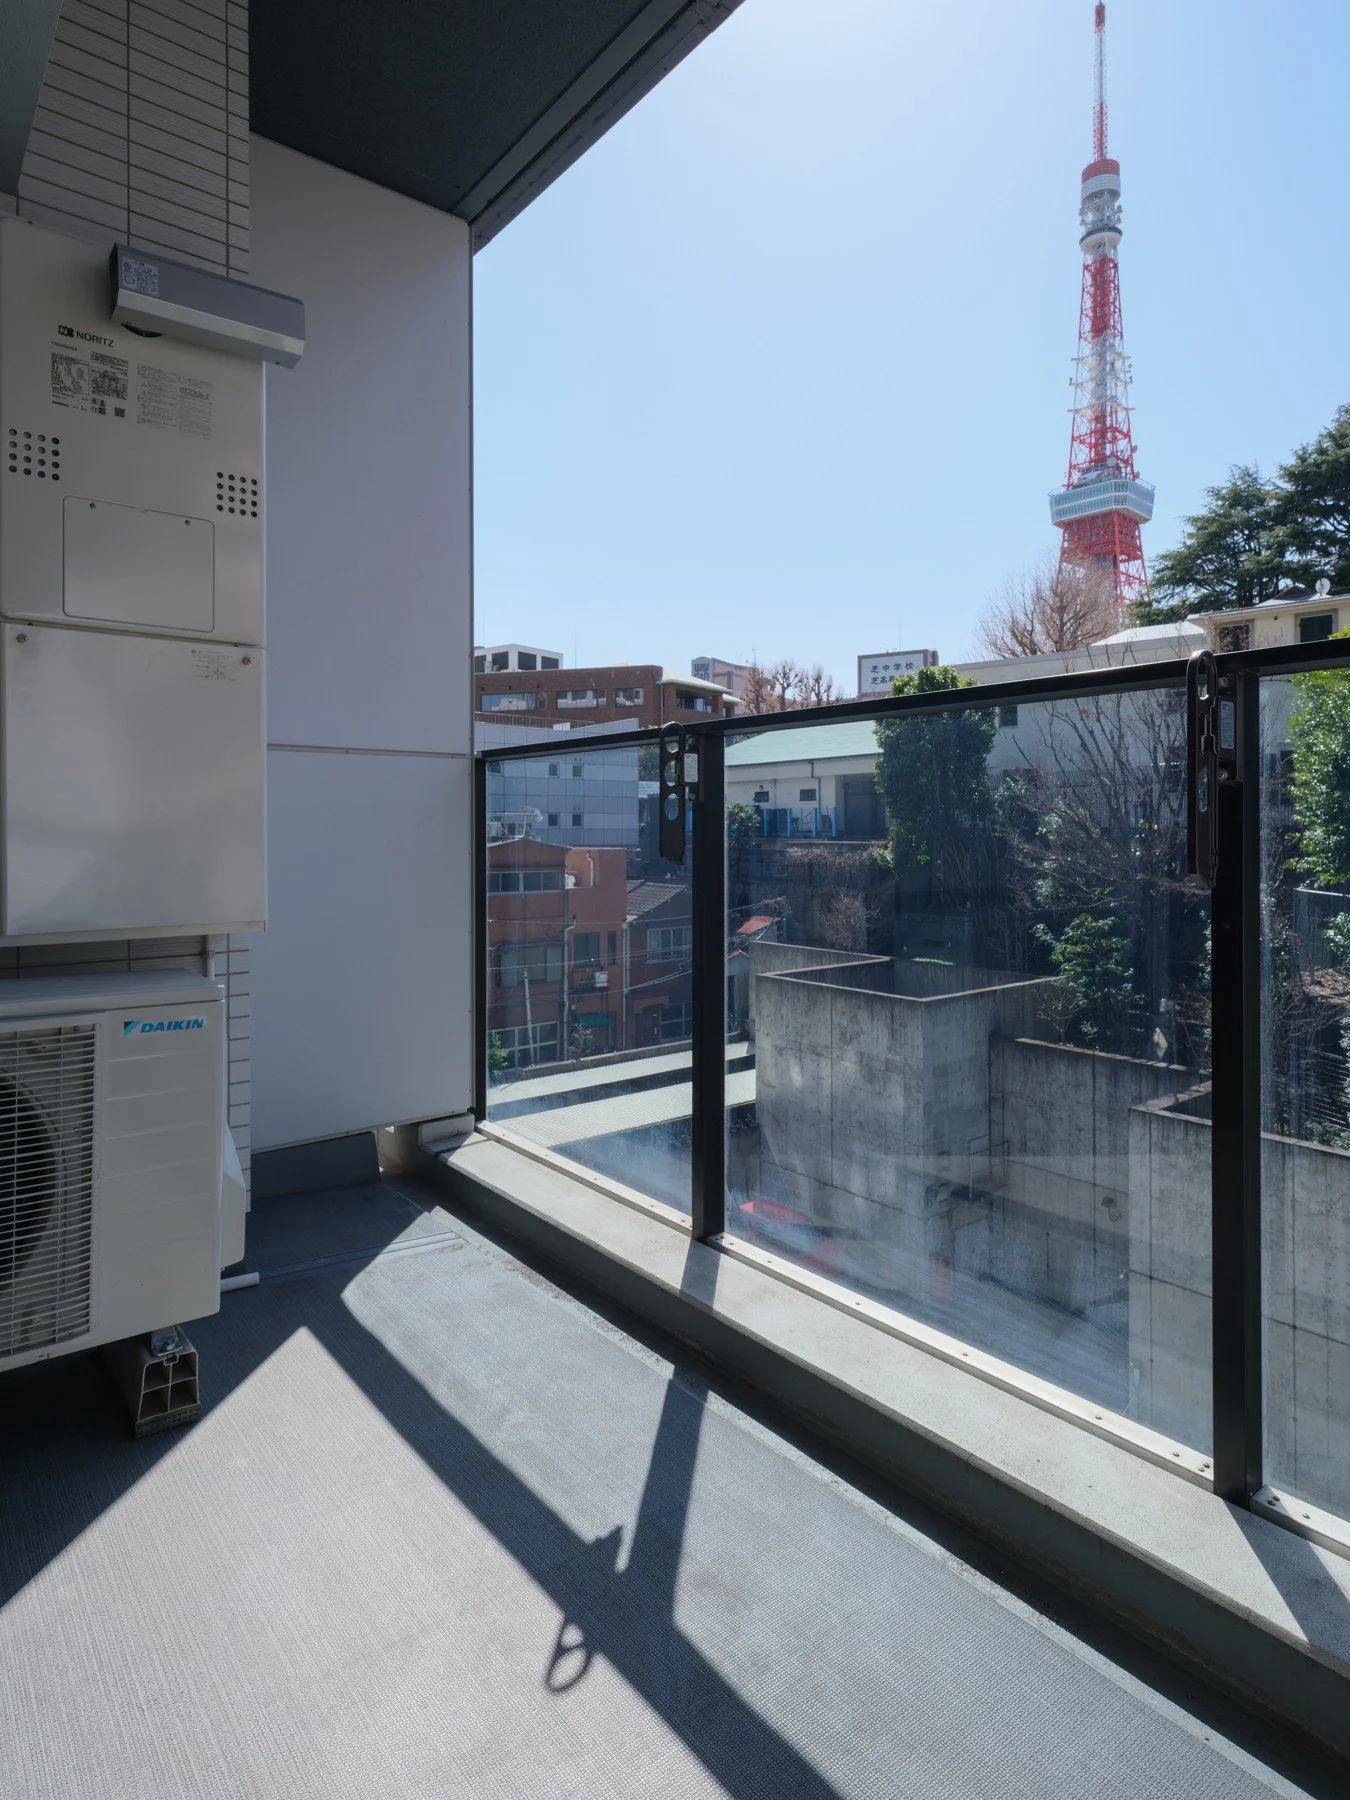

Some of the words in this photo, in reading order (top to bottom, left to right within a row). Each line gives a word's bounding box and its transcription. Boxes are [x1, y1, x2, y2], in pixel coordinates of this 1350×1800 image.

[75, 330, 115, 348] NORITZ
[871, 662, 914, 673] 芝中学校
[140, 1018, 205, 1034] DAIKIN
